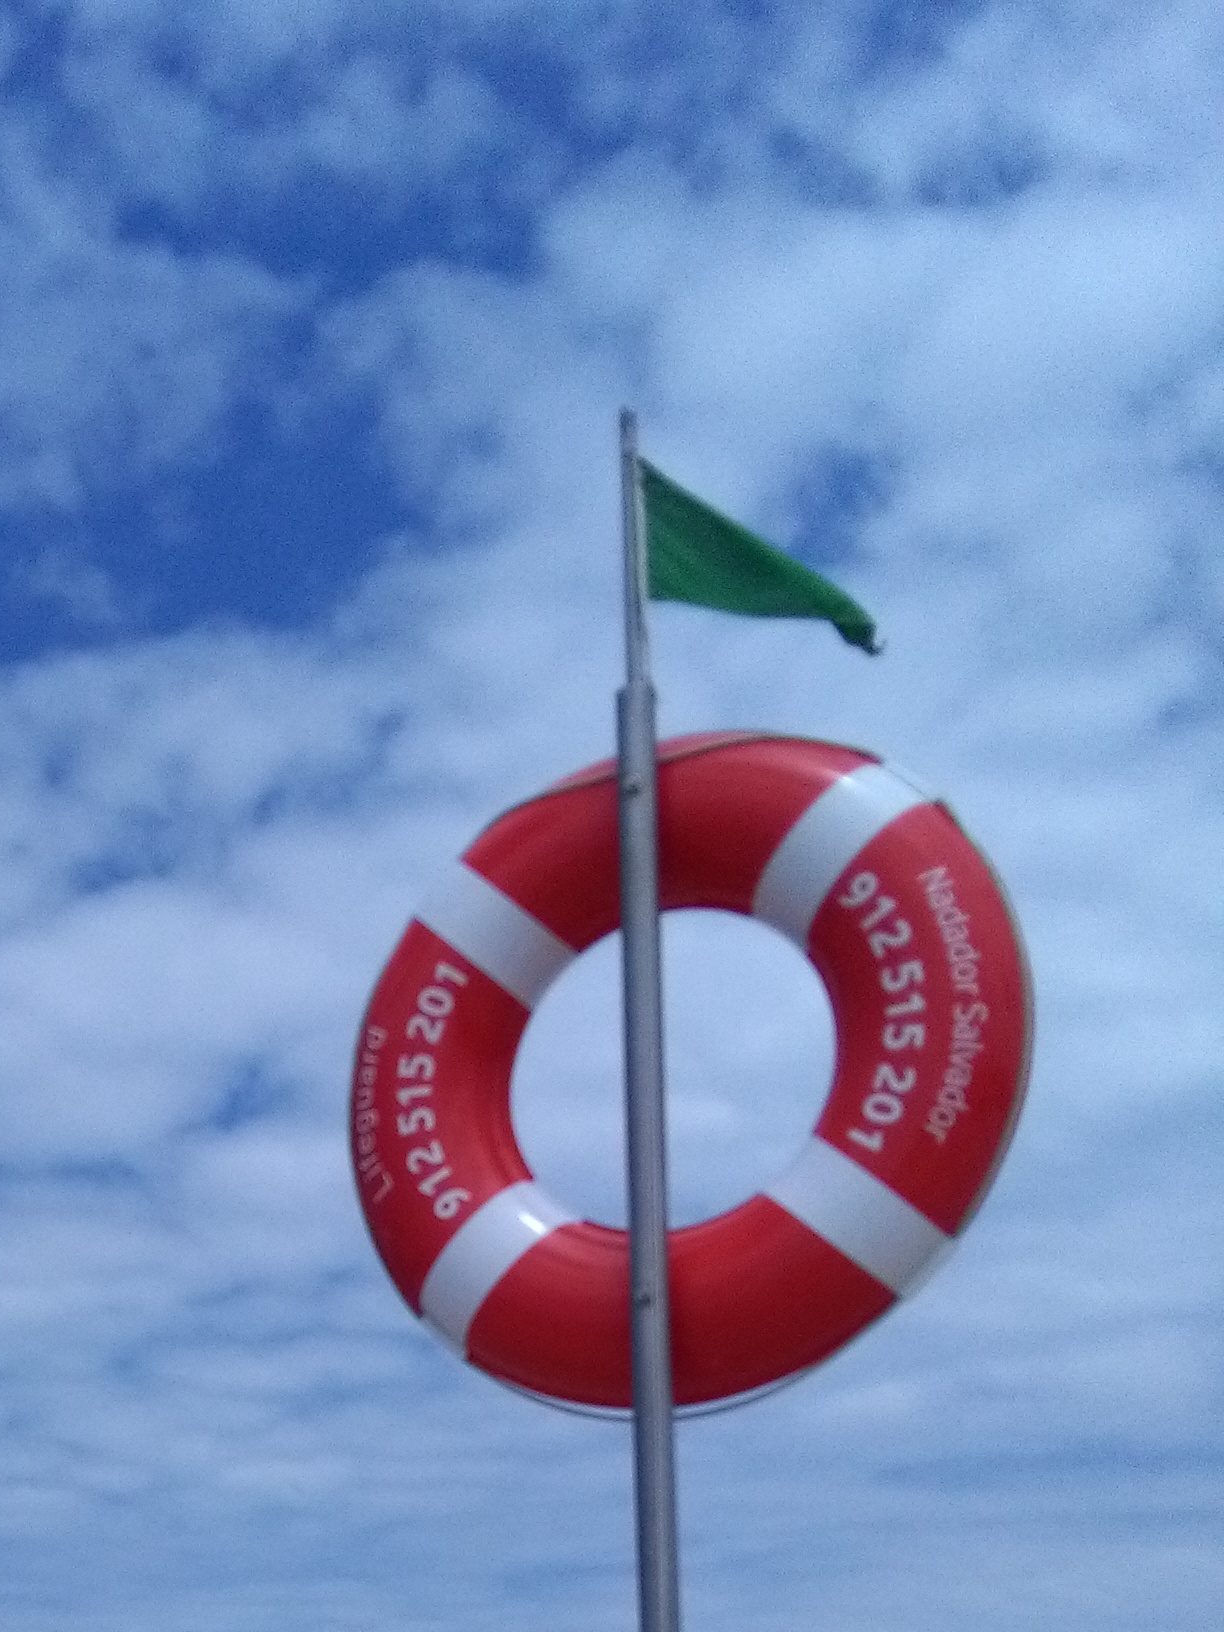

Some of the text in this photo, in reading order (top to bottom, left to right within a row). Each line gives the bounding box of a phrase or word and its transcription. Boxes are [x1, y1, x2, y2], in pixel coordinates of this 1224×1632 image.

[355, 1025, 393, 1202] Lifeguard
[396, 961, 472, 1220] 912 515 201
[838, 871, 925, 1152] 912 515 201
[916, 865, 990, 1144] Nadador Salvador
